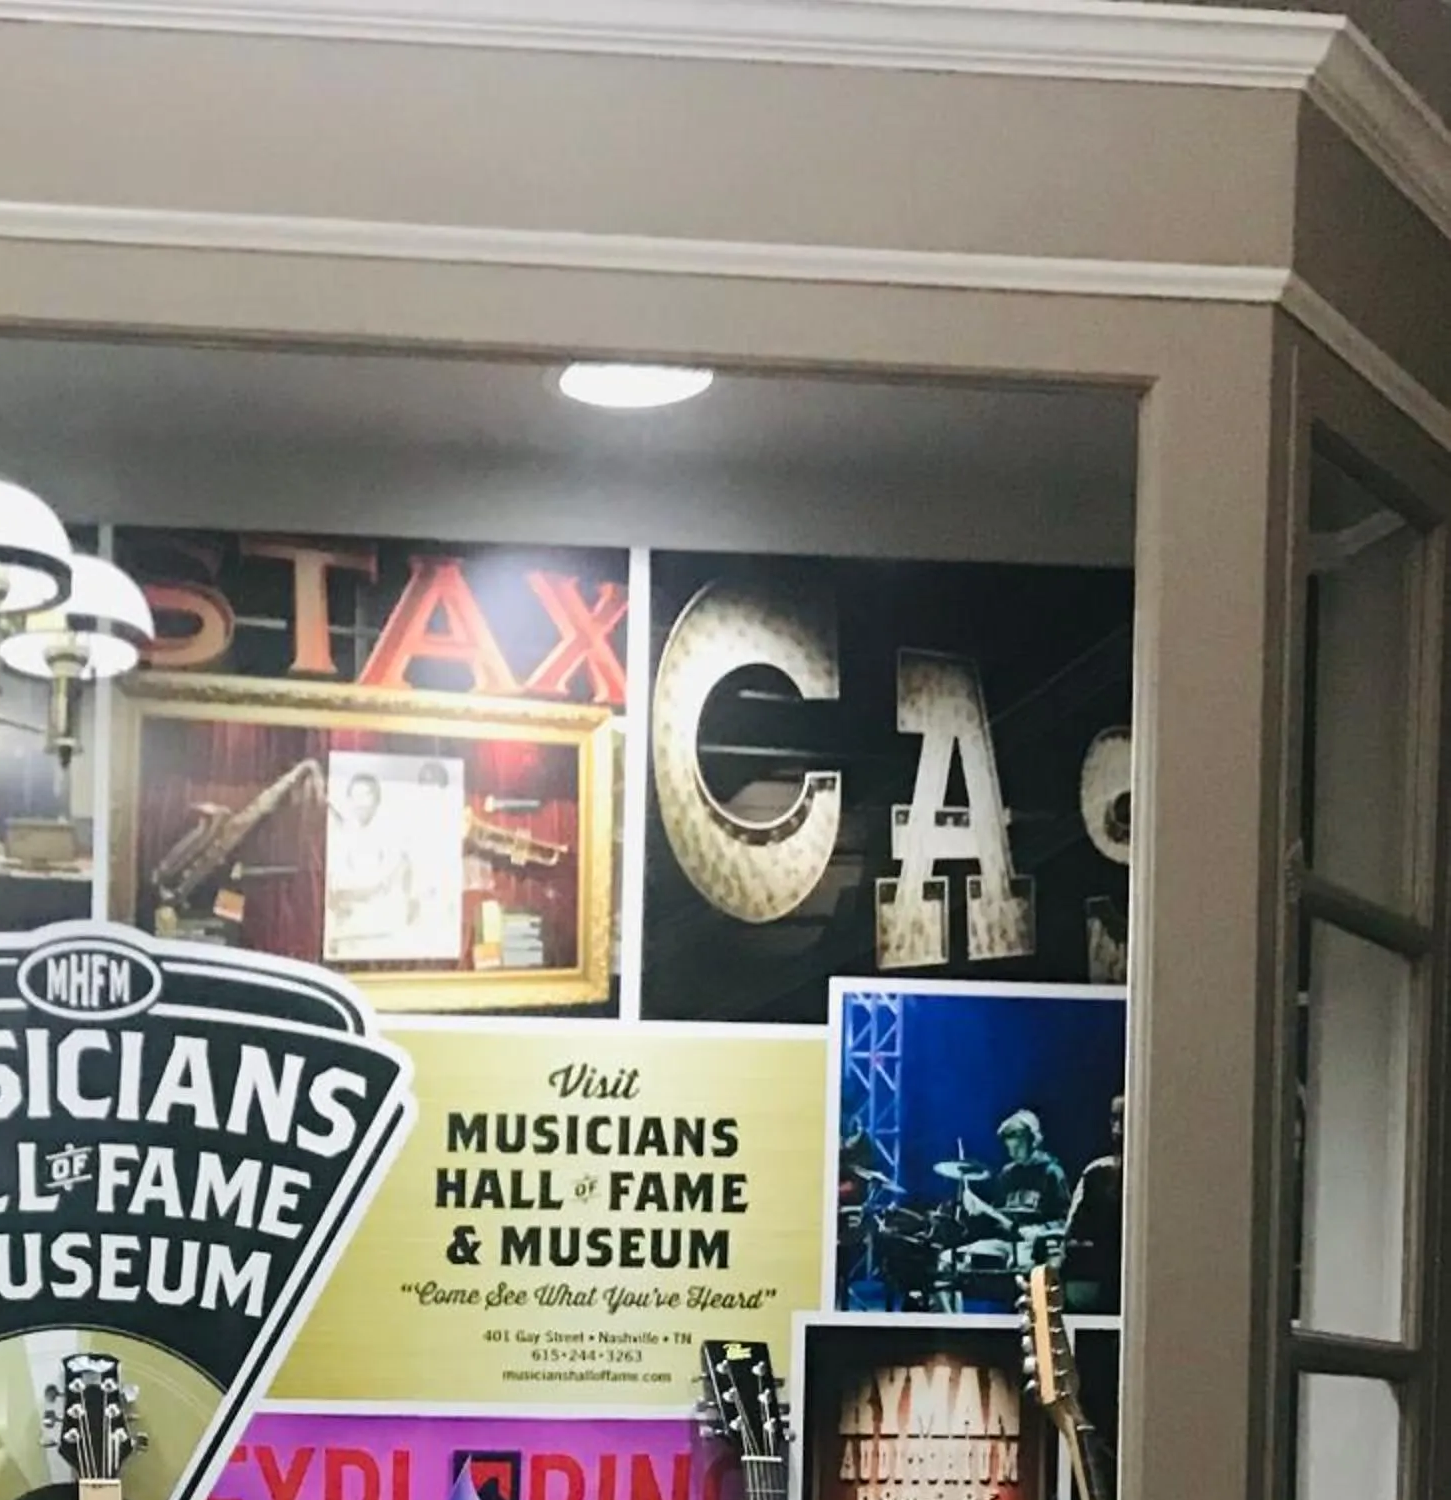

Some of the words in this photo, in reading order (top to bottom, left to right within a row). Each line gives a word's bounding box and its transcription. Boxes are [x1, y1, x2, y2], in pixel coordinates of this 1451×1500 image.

[46, 951, 131, 1006] MHFM
[547, 1062, 641, 1100] Visit
[446, 1111, 739, 1159] MUSICIANS
[51, 1153, 91, 1181] OF
[96, 1143, 311, 1240] FAME
[434, 1167, 564, 1210] HALL
[574, 1178, 599, 1198] OF
[608, 1170, 750, 1214] FAME
[445, 1224, 482, 1267] &
[500, 1225, 730, 1270] MUSEUM
[484, 1280, 528, 1311] See
[532, 1284, 598, 1310] What
[482, 1330, 510, 1343] 401
[515, 1330, 541, 1345] Gay
[546, 1330, 585, 1343] Street
[598, 1331, 659, 1345] Nashville
[672, 1332, 693, 1345] TN
[502, 1369, 673, 1384] musicianshalloffame.com
